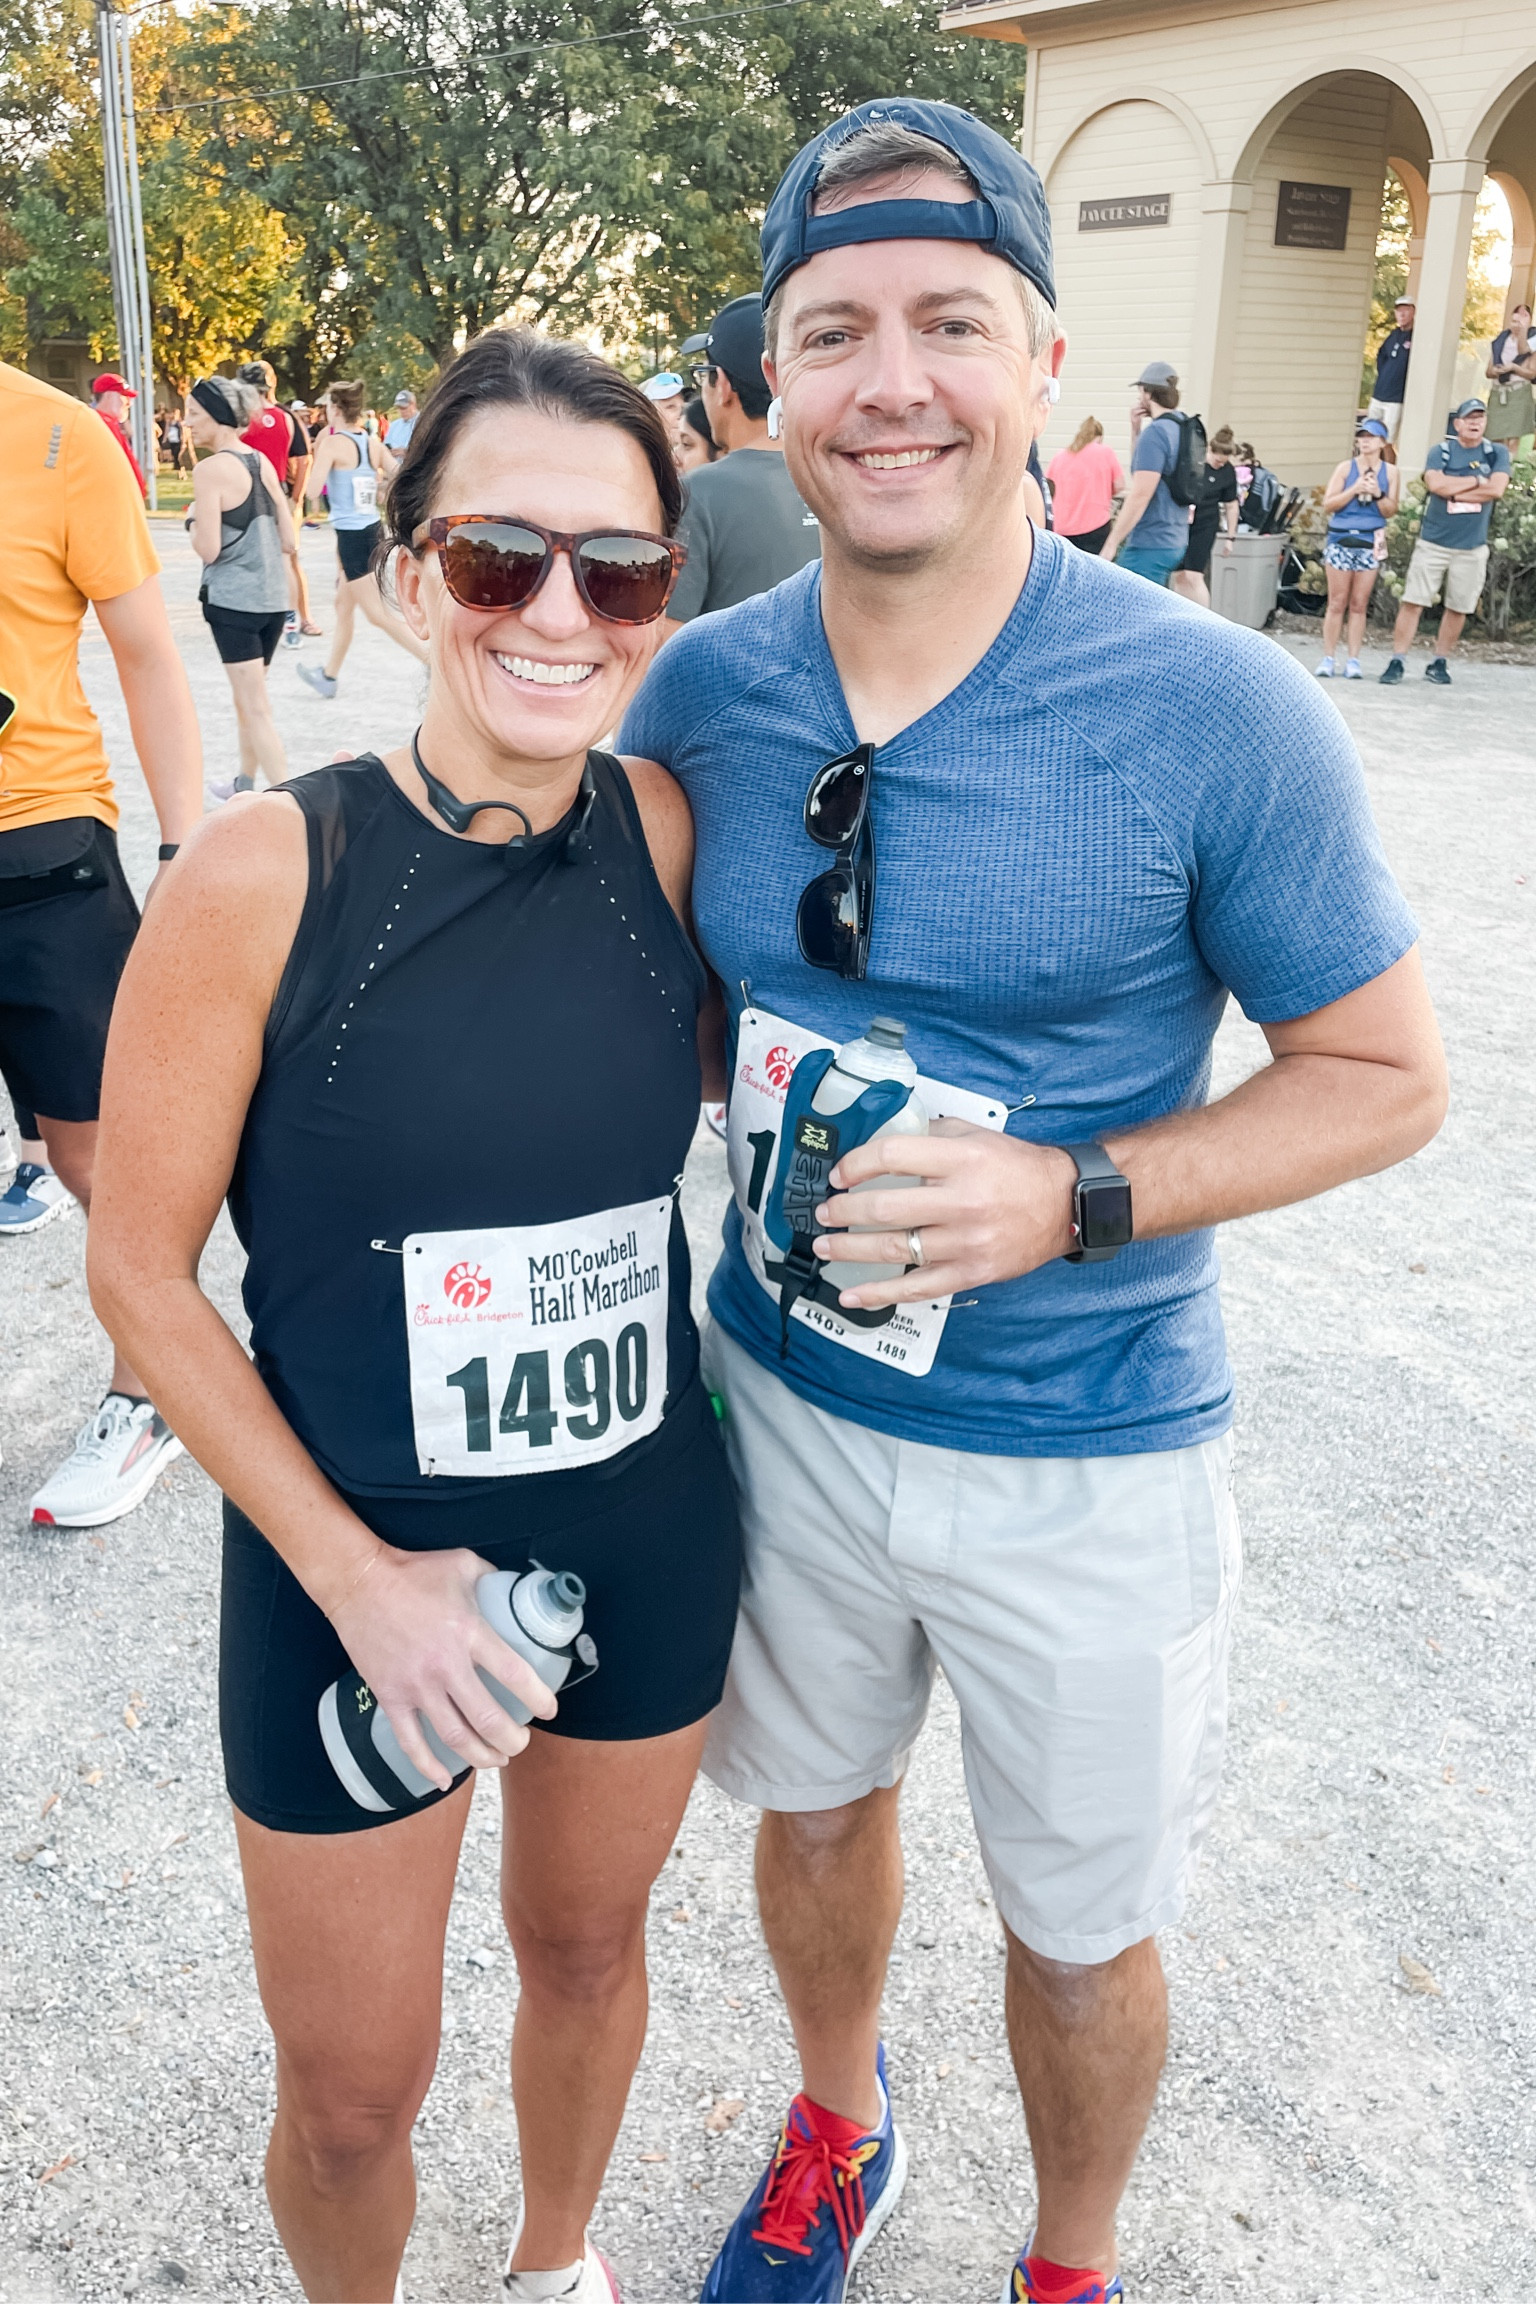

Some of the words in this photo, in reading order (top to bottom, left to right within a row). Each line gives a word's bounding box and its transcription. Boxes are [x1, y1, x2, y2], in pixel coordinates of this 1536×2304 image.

[1127, 202, 1169, 219] STAGE
[530, 1281, 577, 1326] Half
[582, 1261, 661, 1317] Marathon
[476, 1311, 524, 1323] Bridgeton
[894, 1313, 914, 1326] EER
[876, 1340, 907, 1361] 1489
[446, 1321, 648, 1453] 1490
